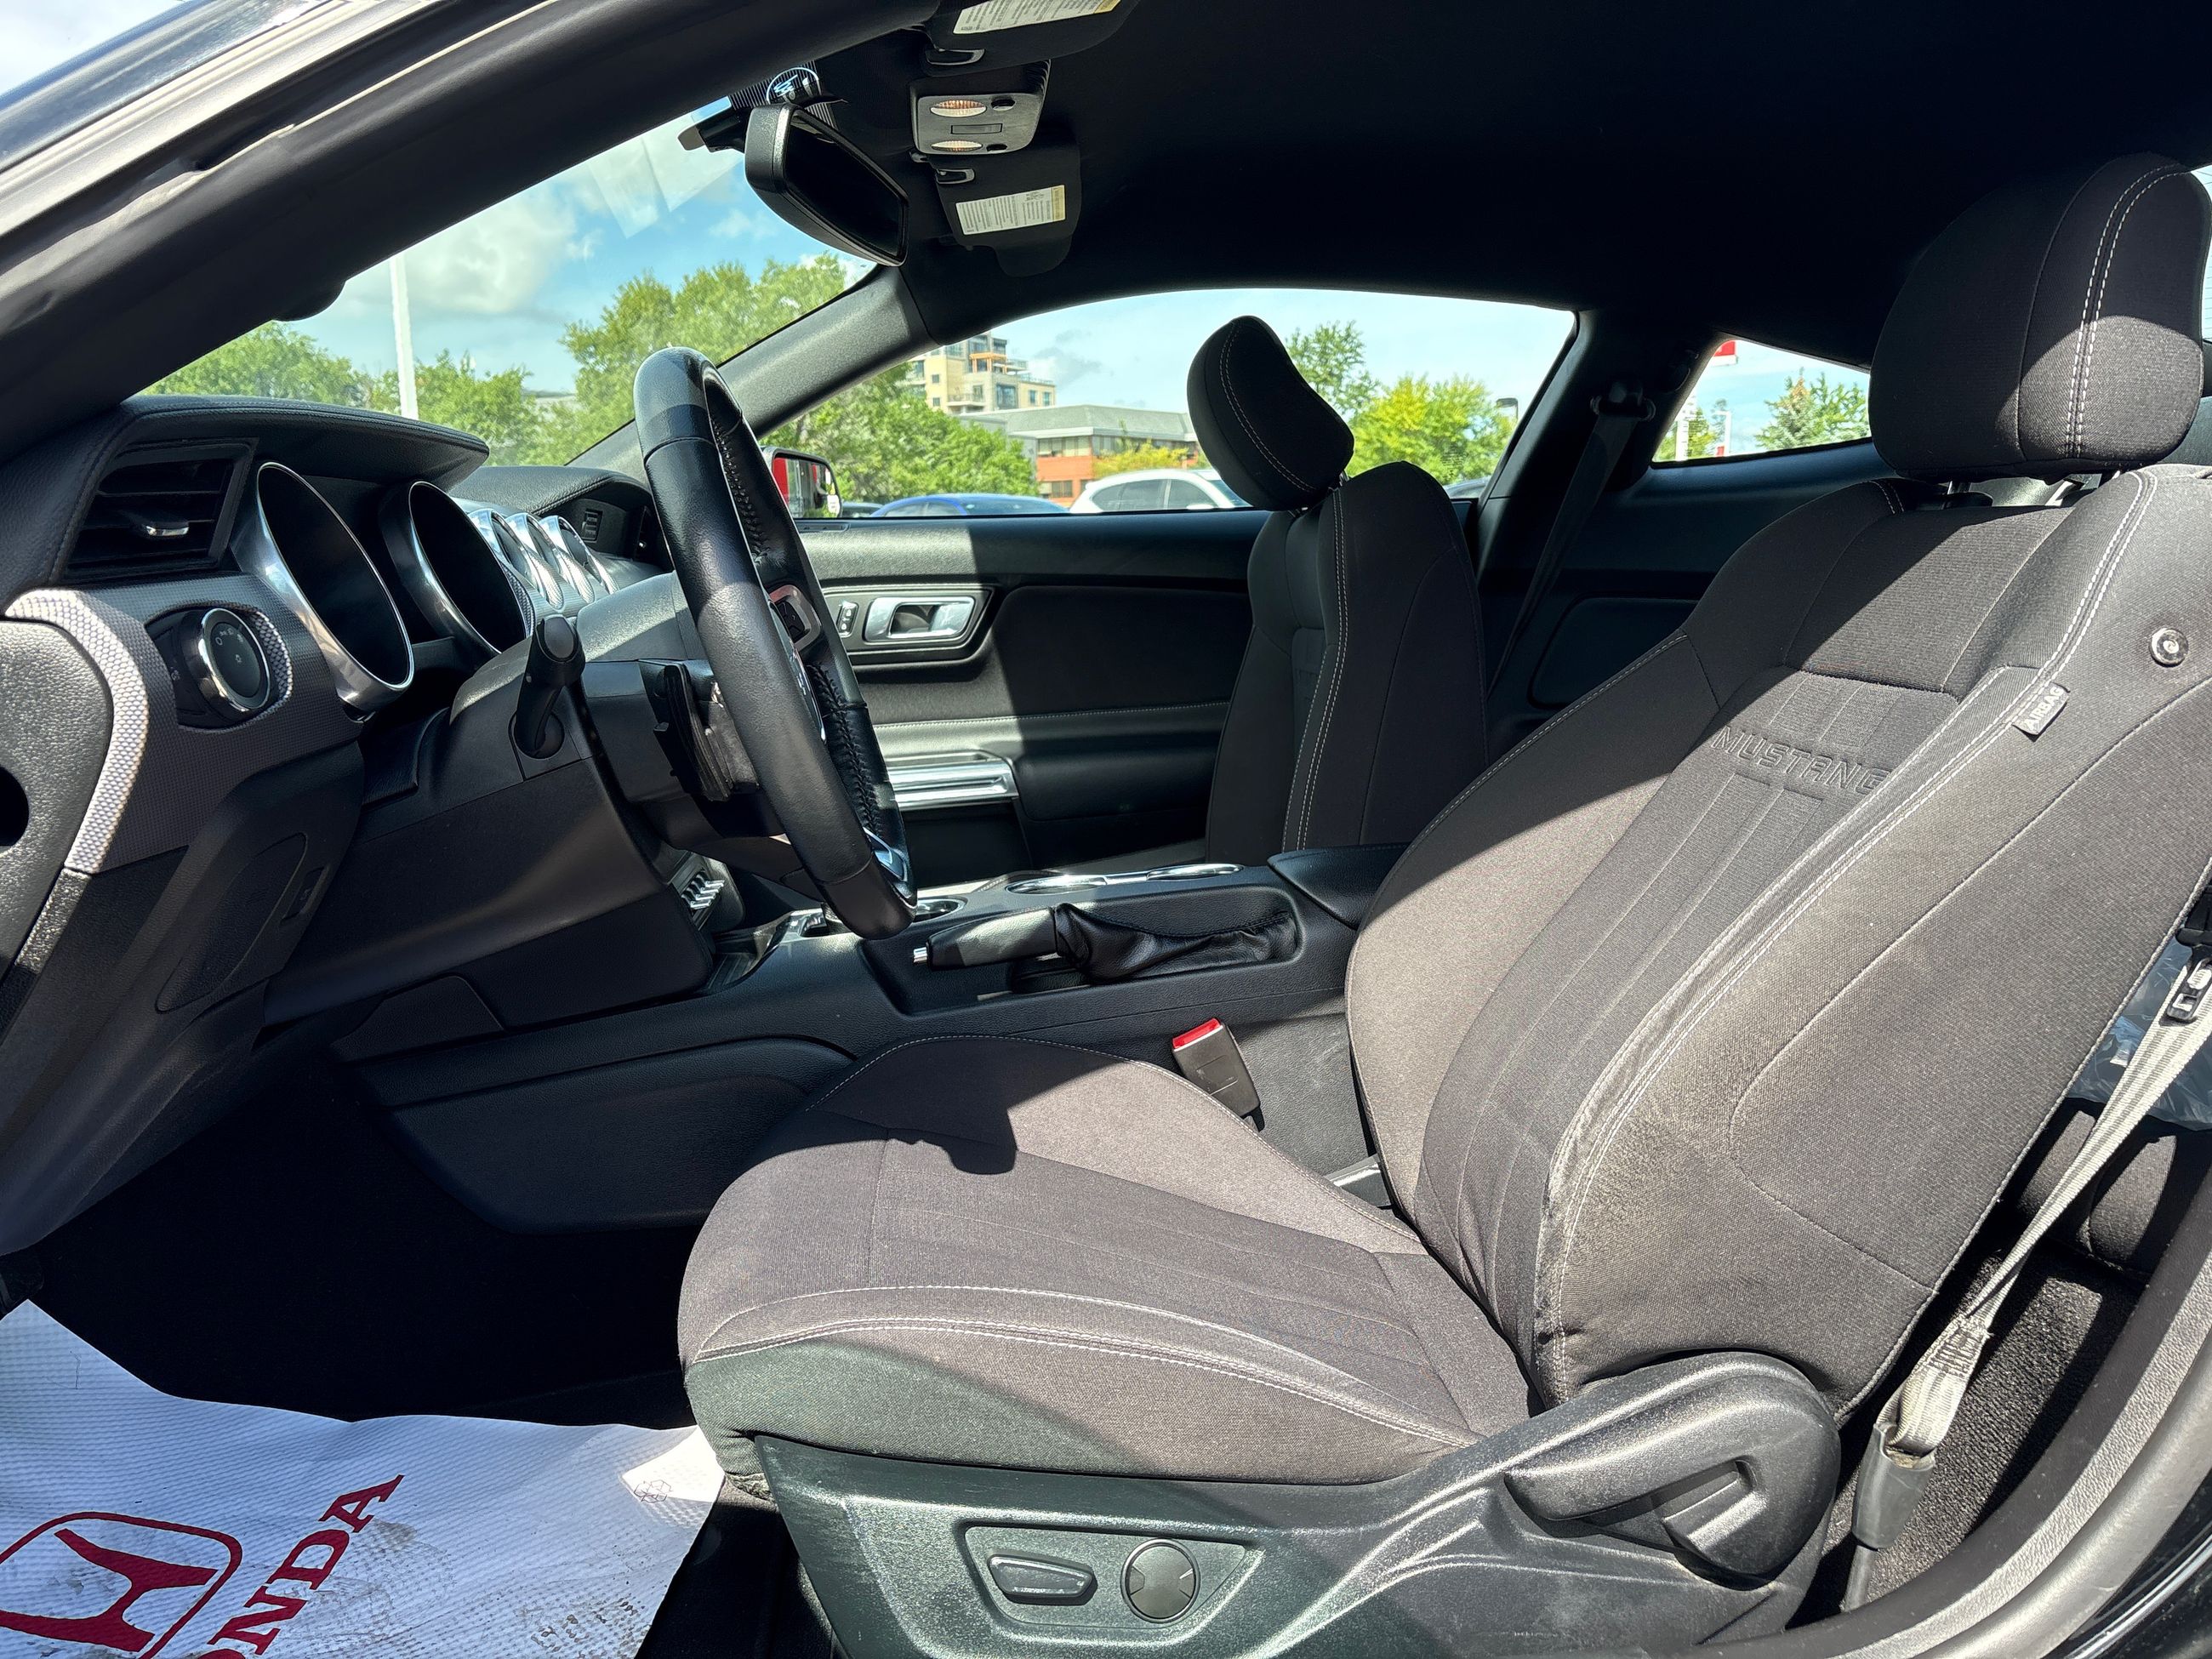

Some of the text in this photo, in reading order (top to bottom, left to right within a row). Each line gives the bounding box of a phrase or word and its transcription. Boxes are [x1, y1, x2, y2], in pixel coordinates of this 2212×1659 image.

[2024, 686, 2064, 731] AIRBAG
[1711, 725, 1893, 795] MUSTANG
[197, 1474, 405, 1659] NDA
